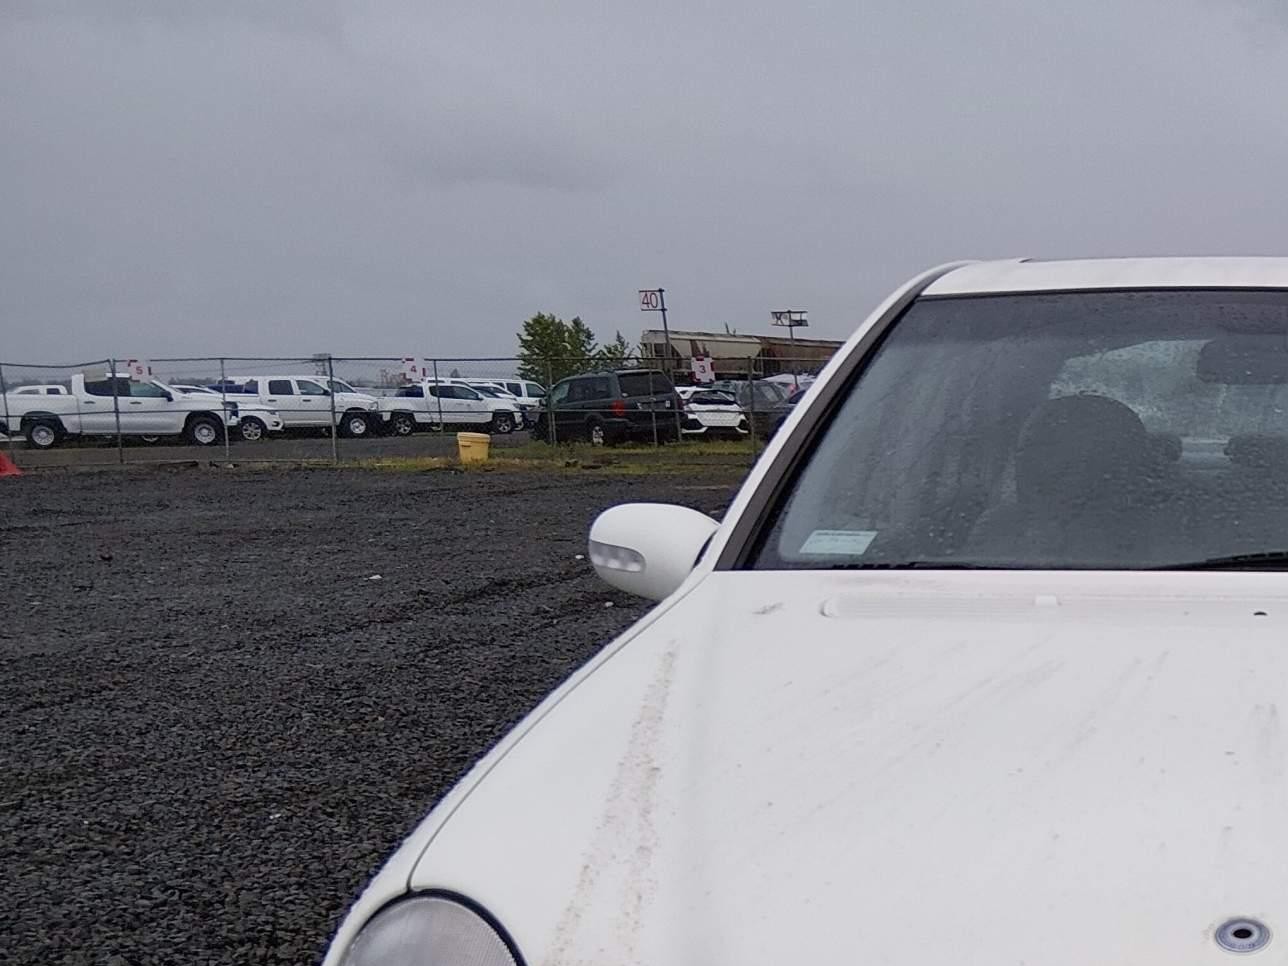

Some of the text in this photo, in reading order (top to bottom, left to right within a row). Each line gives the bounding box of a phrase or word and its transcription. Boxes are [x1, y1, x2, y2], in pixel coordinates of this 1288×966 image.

[642, 291, 658, 309] 40
[136, 366, 143, 375] 5
[699, 365, 706, 374] 3
